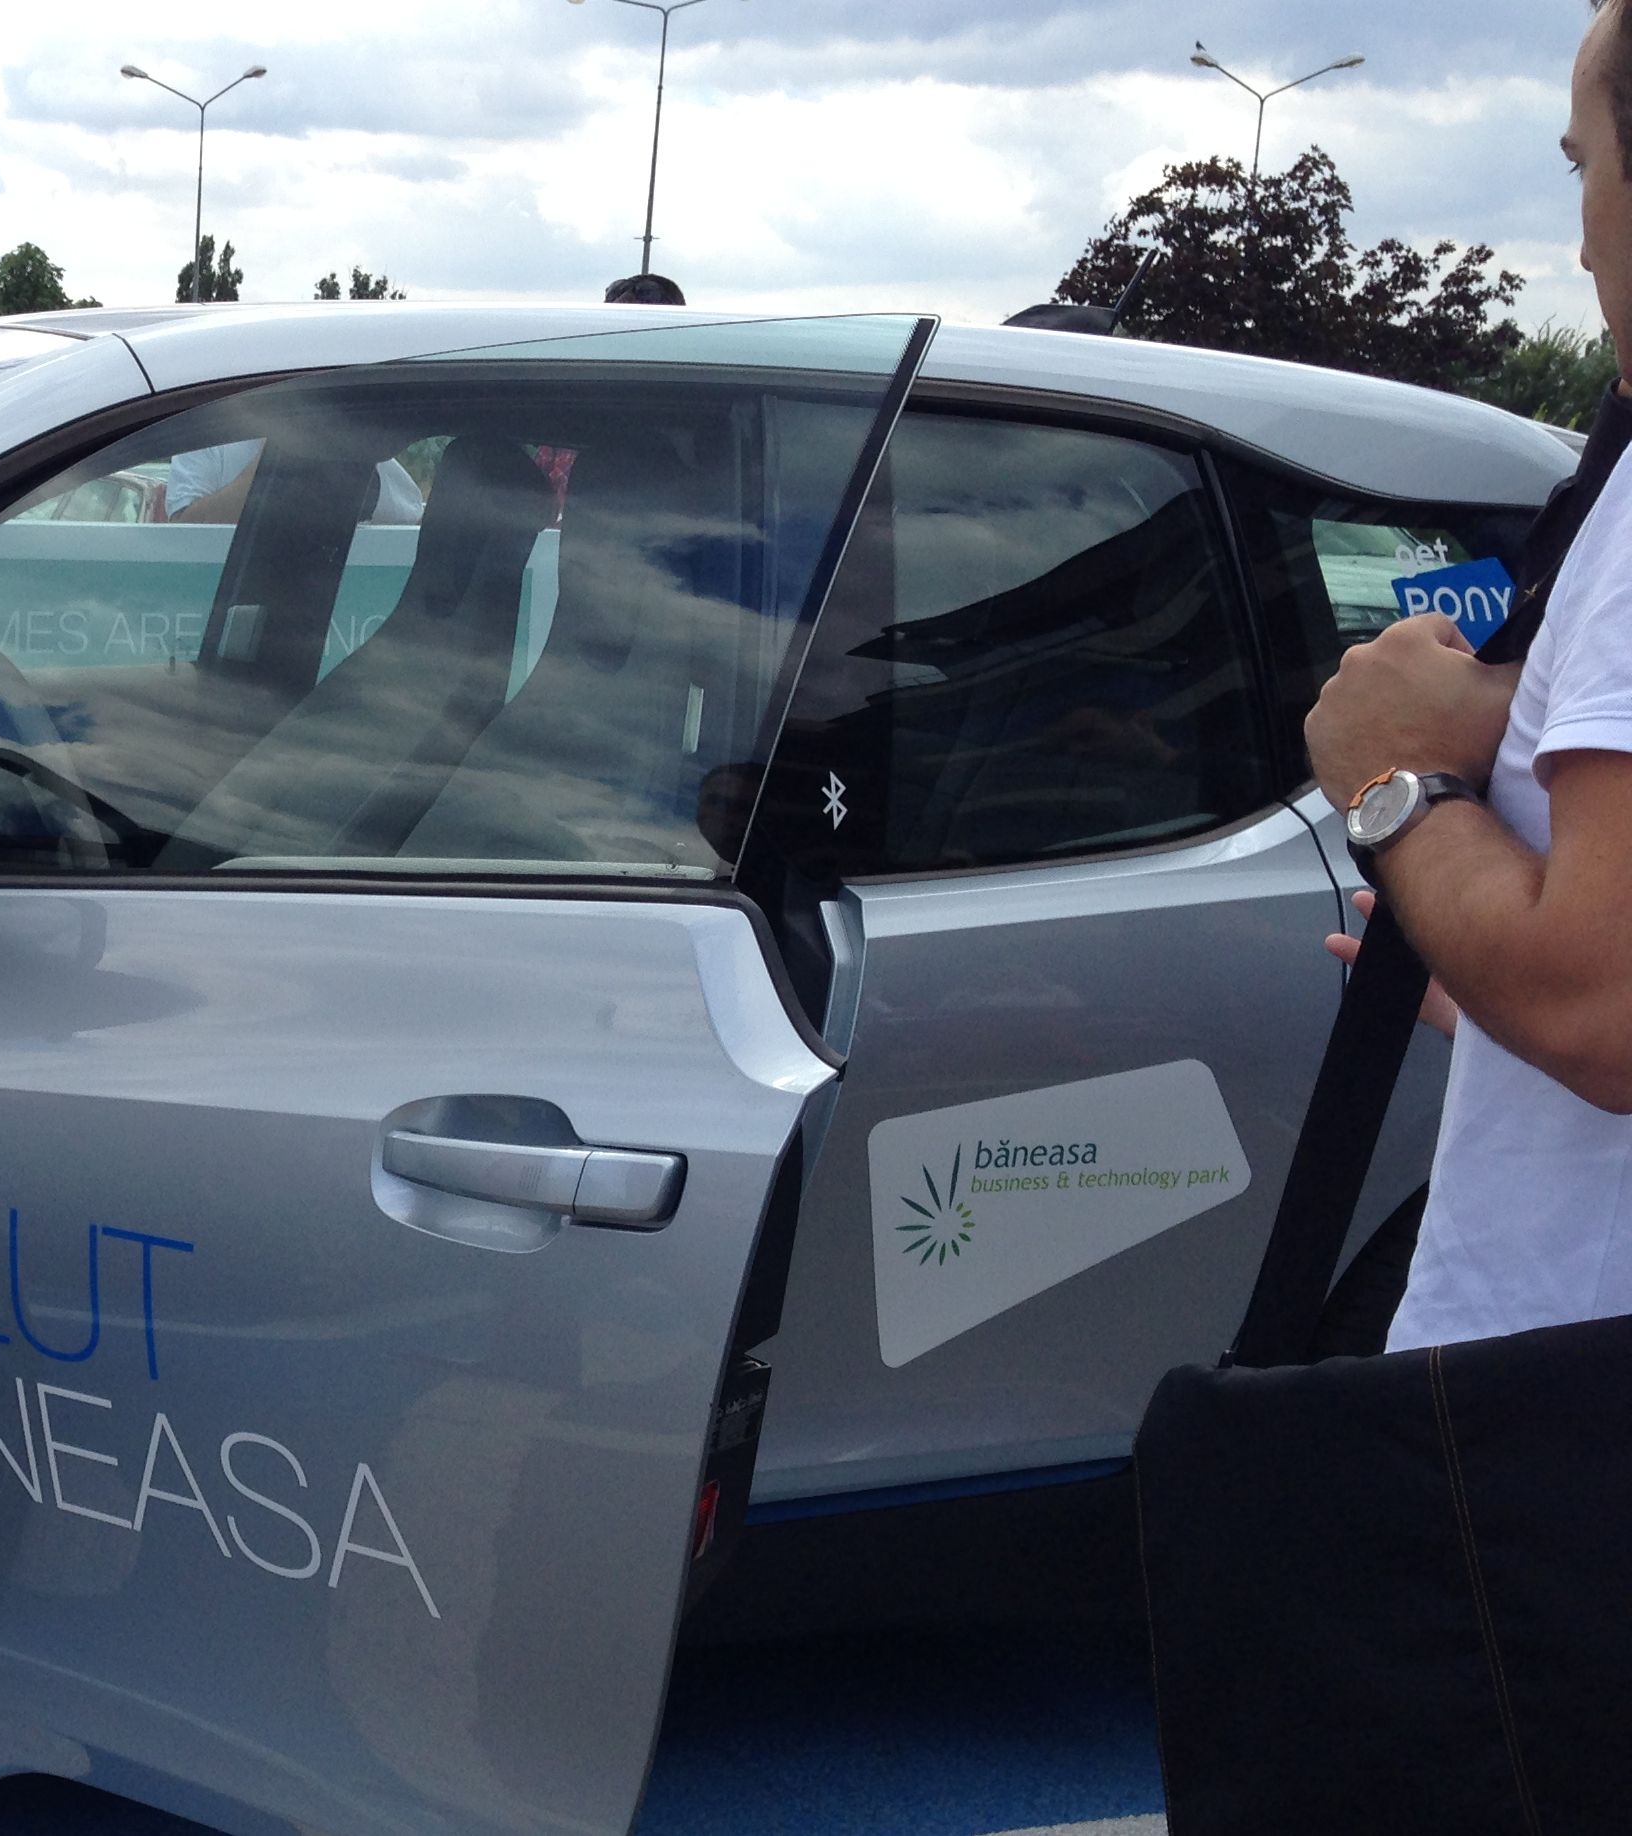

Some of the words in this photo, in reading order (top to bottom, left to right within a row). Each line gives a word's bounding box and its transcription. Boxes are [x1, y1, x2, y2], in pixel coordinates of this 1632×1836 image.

[1395, 537, 1448, 578] get
[103, 612, 203, 656] ARE
[974, 1140, 1097, 1169] băneasa
[971, 1175, 1049, 1193] business
[1057, 1171, 1068, 1189] &
[1078, 1168, 1181, 1189] technology
[1187, 1165, 1230, 1187] park
